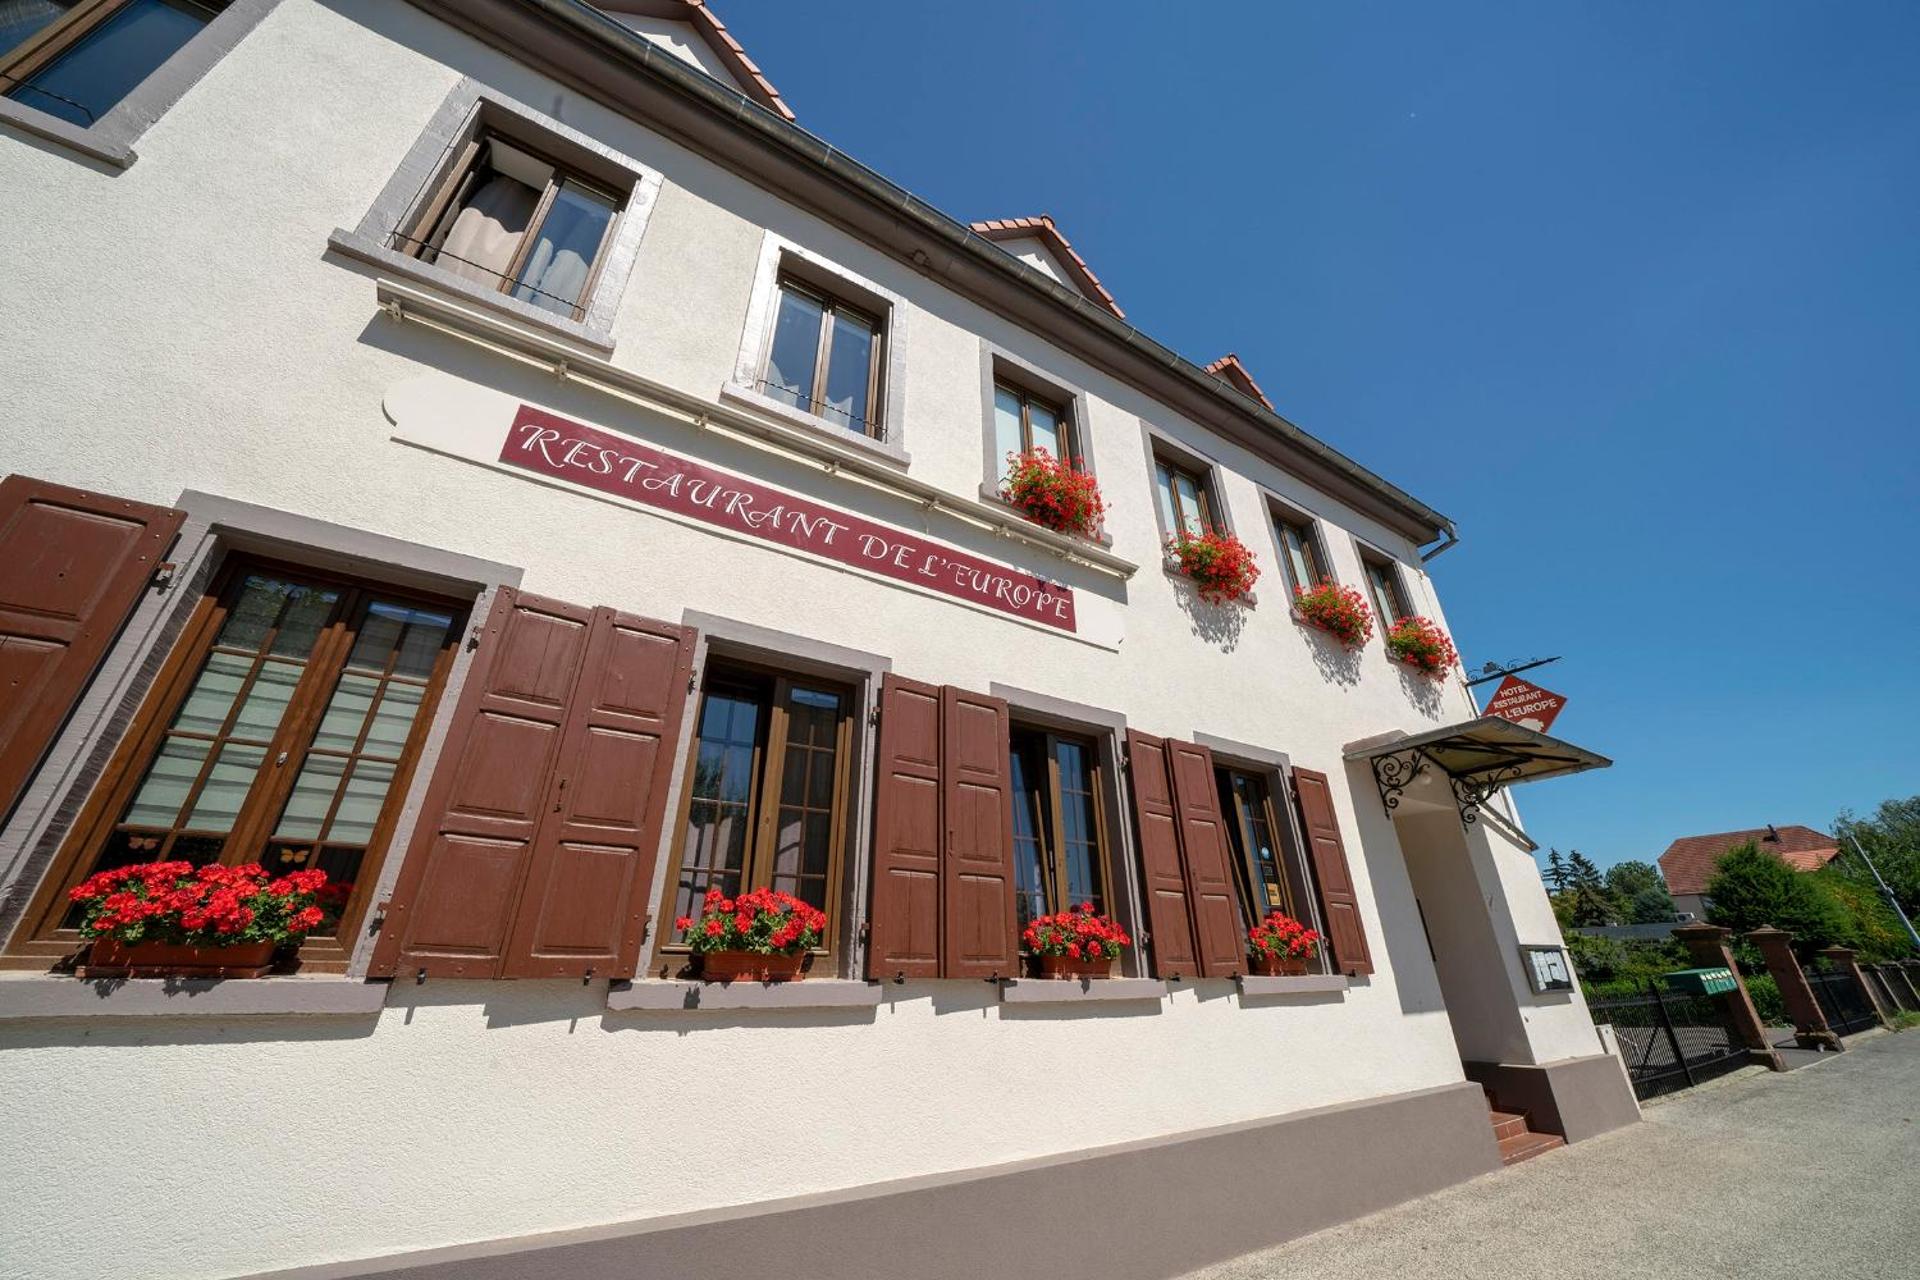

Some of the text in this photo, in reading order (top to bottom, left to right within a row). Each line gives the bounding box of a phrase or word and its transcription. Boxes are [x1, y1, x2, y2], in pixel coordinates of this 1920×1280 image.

[519, 424, 1071, 620] RESTAURANT DE L'EUROPE
[1493, 690, 1543, 709] RESTAURANT
[1500, 684, 1530, 698] HOTEL
[1504, 698, 1558, 719] L'EUROPE
